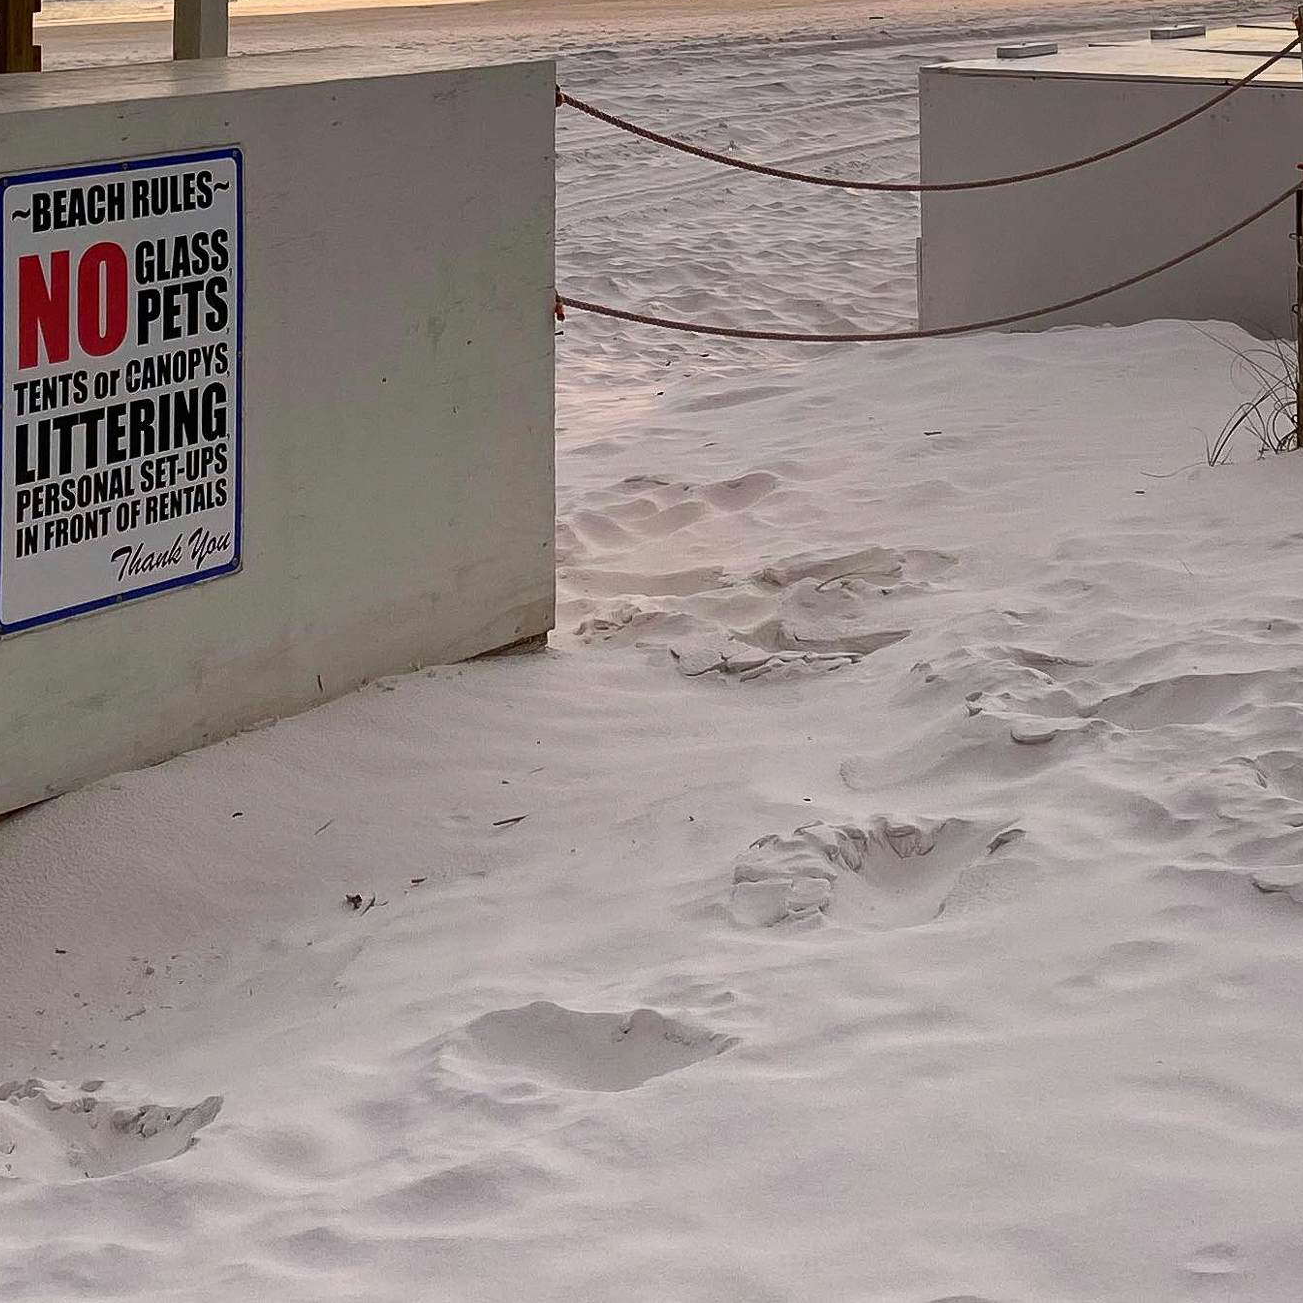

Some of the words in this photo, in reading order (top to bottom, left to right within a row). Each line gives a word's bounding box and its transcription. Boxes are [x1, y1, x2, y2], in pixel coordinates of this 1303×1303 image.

[17, 241, 129, 371] NO
[13, 370, 88, 417] TENTS
[94, 369, 121, 400] or
[15, 522, 39, 558] IN
[44, 506, 111, 551] FRONT
[116, 499, 141, 532] OF
[145, 478, 228, 526] RENTALS
[16, 465, 135, 524] PERSONAL
[140, 443, 228, 492] SET-UPS
[110, 533, 184, 582] Thank
[187, 527, 231, 570] You
